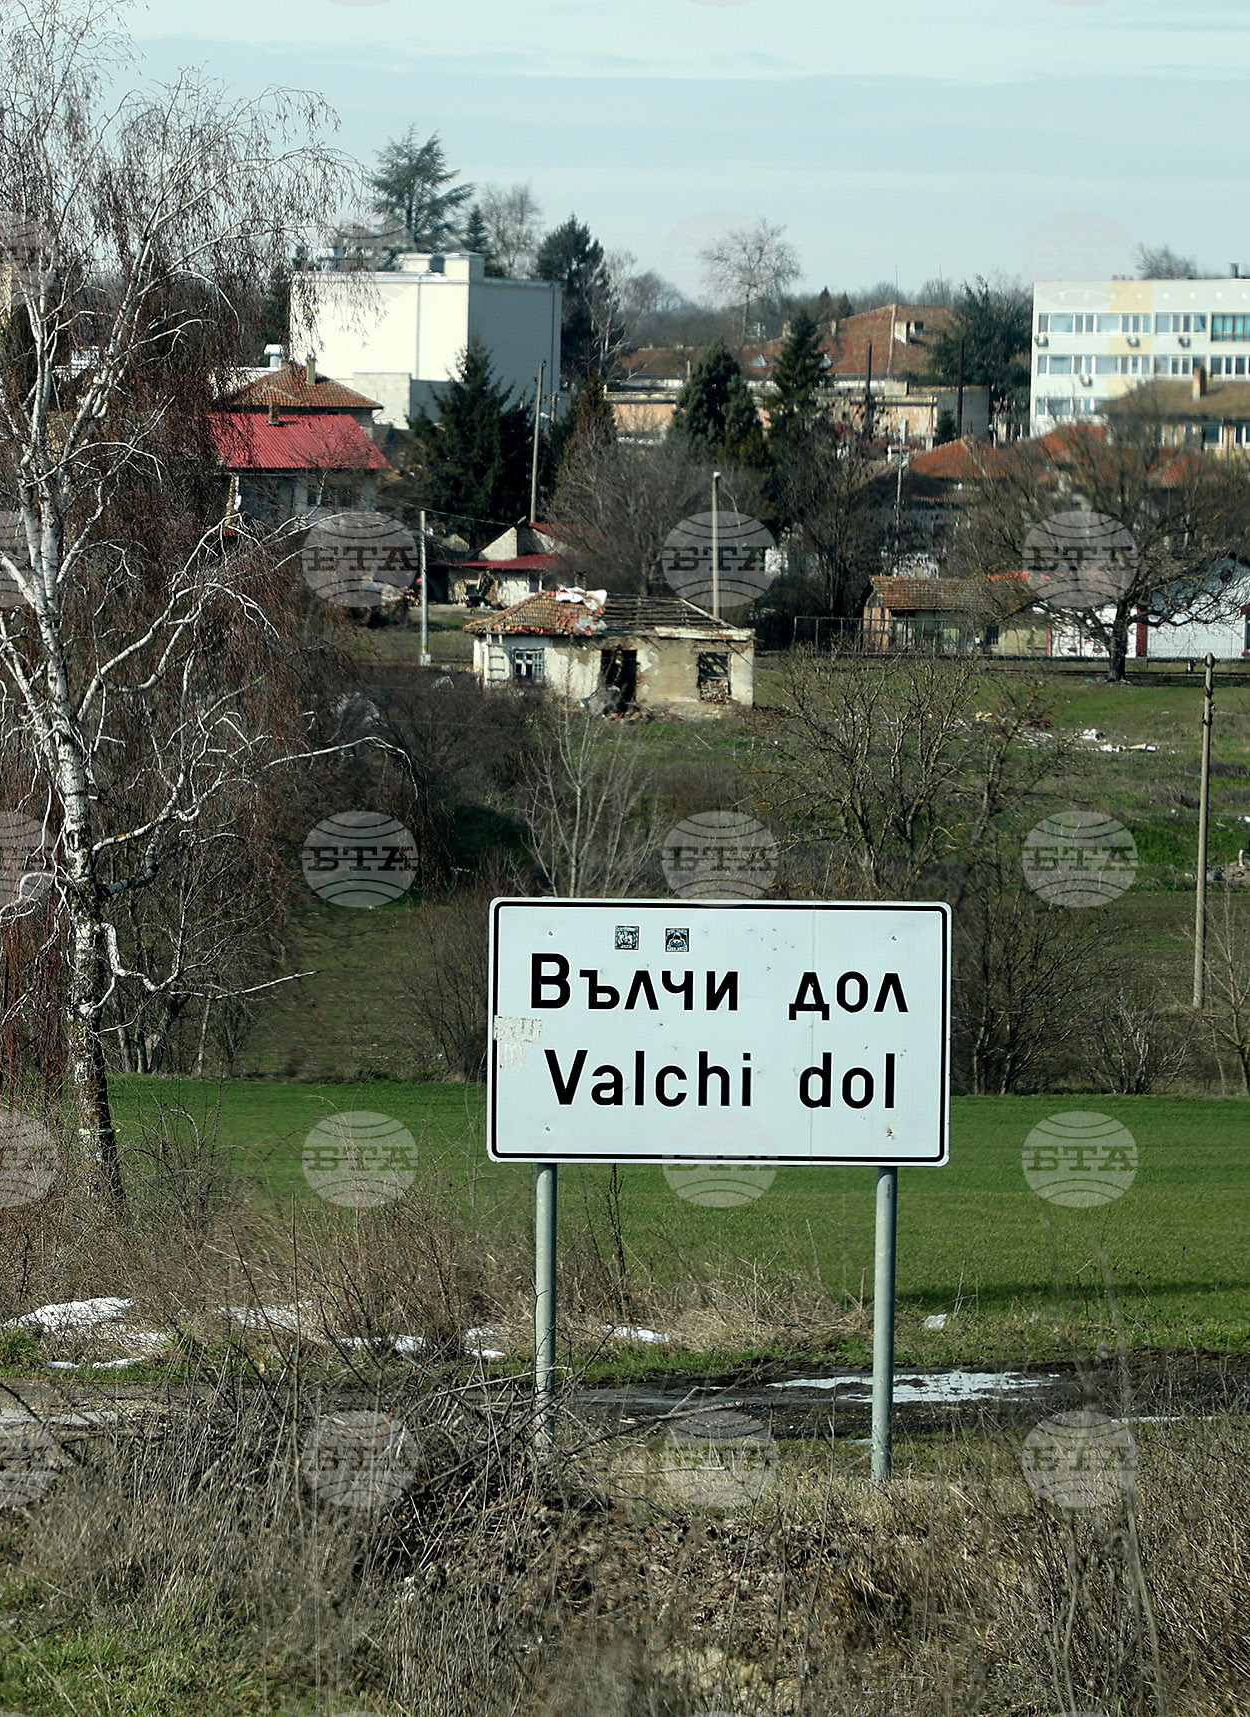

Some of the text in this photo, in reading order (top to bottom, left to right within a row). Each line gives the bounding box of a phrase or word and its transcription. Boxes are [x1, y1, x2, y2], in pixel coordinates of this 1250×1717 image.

[530, 952, 908, 1021] Вълчи дол
[544, 1049, 896, 1109] Valchi dol
